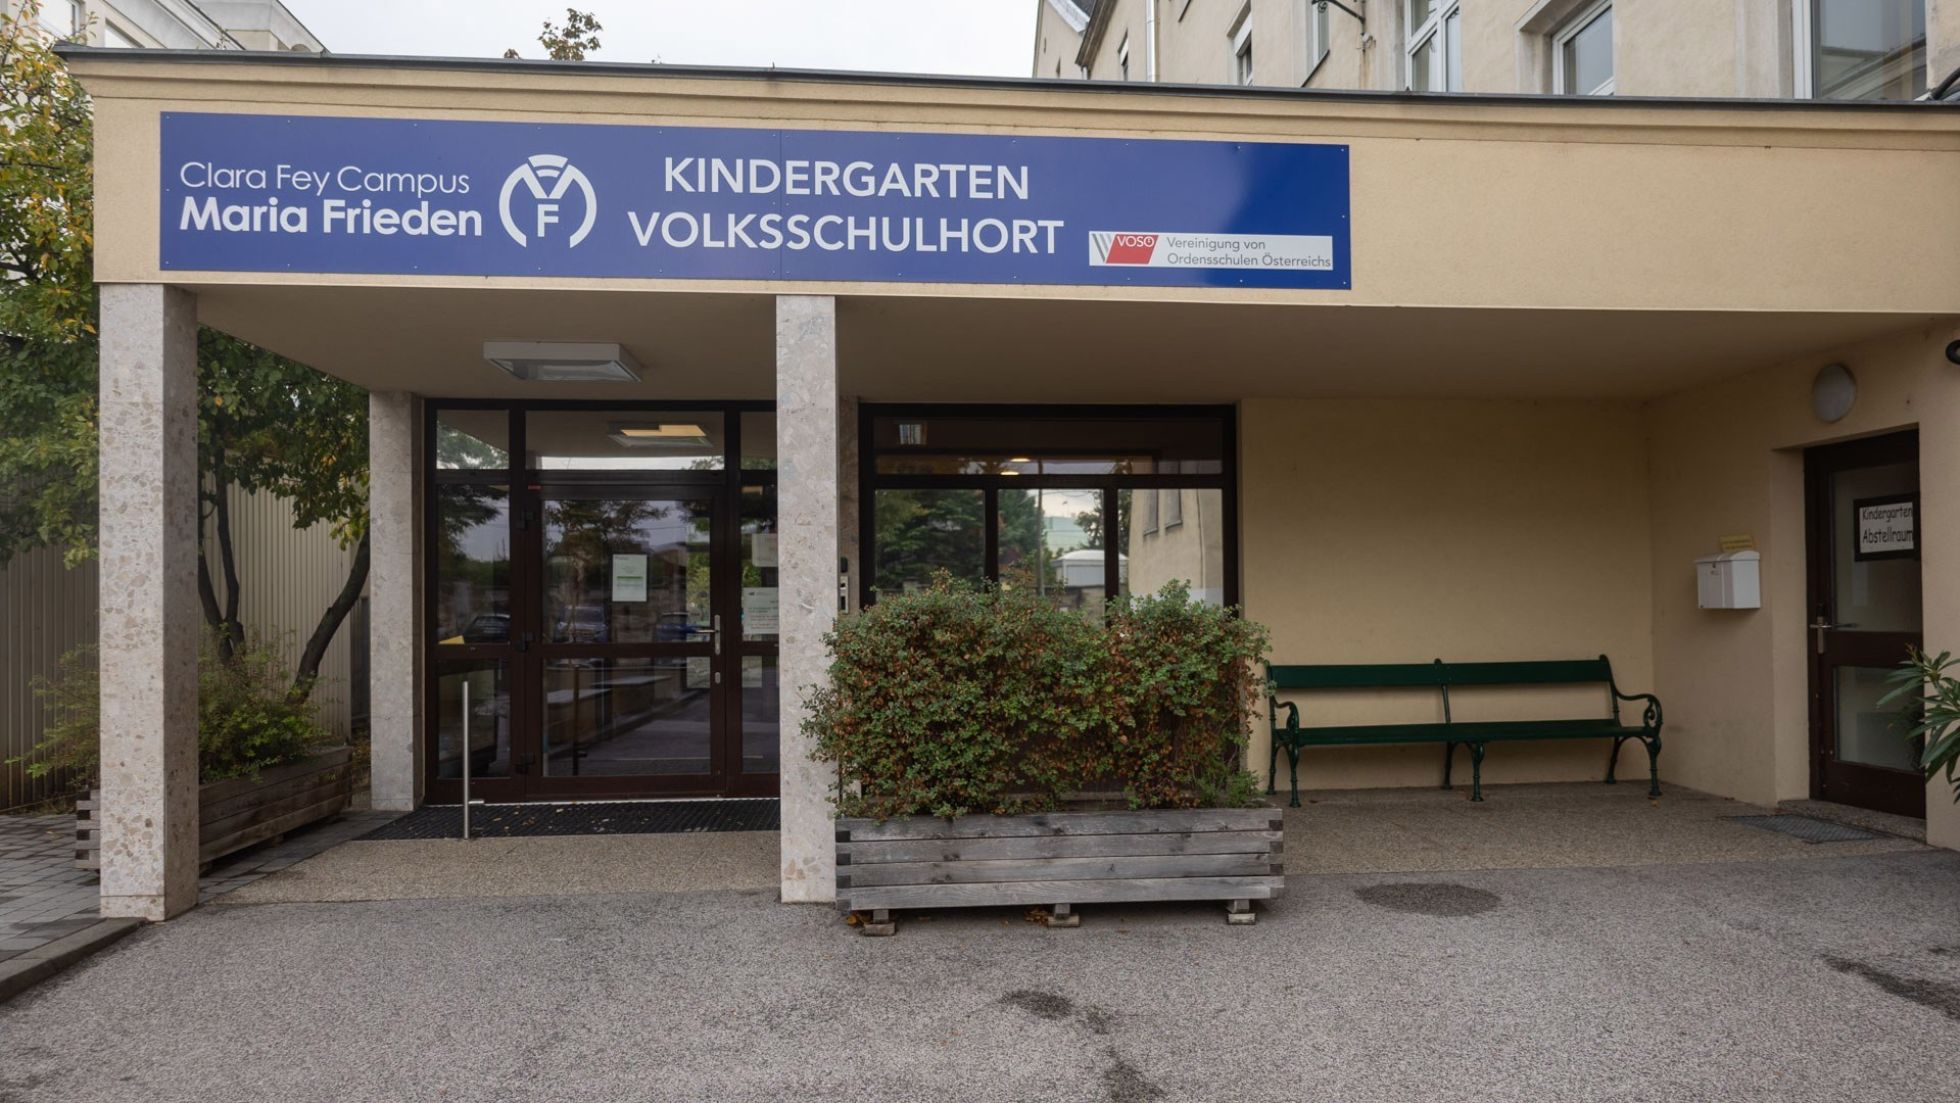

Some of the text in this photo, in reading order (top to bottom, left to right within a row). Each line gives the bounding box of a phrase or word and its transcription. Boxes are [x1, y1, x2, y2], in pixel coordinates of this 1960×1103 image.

[180, 161, 470, 198] Clara Fey Campus
[664, 157, 1029, 200] KINDERGARTEN
[179, 196, 482, 237] Maria Frieden
[627, 211, 1064, 254] VOLKSSCHULHORT
[1166, 236, 1266, 252] Vereinigung von
[1167, 252, 1331, 268] Ordensschulen Österreichs
[1862, 506, 1913, 523] Kindergarten
[1862, 527, 1913, 545] Abstellraum
